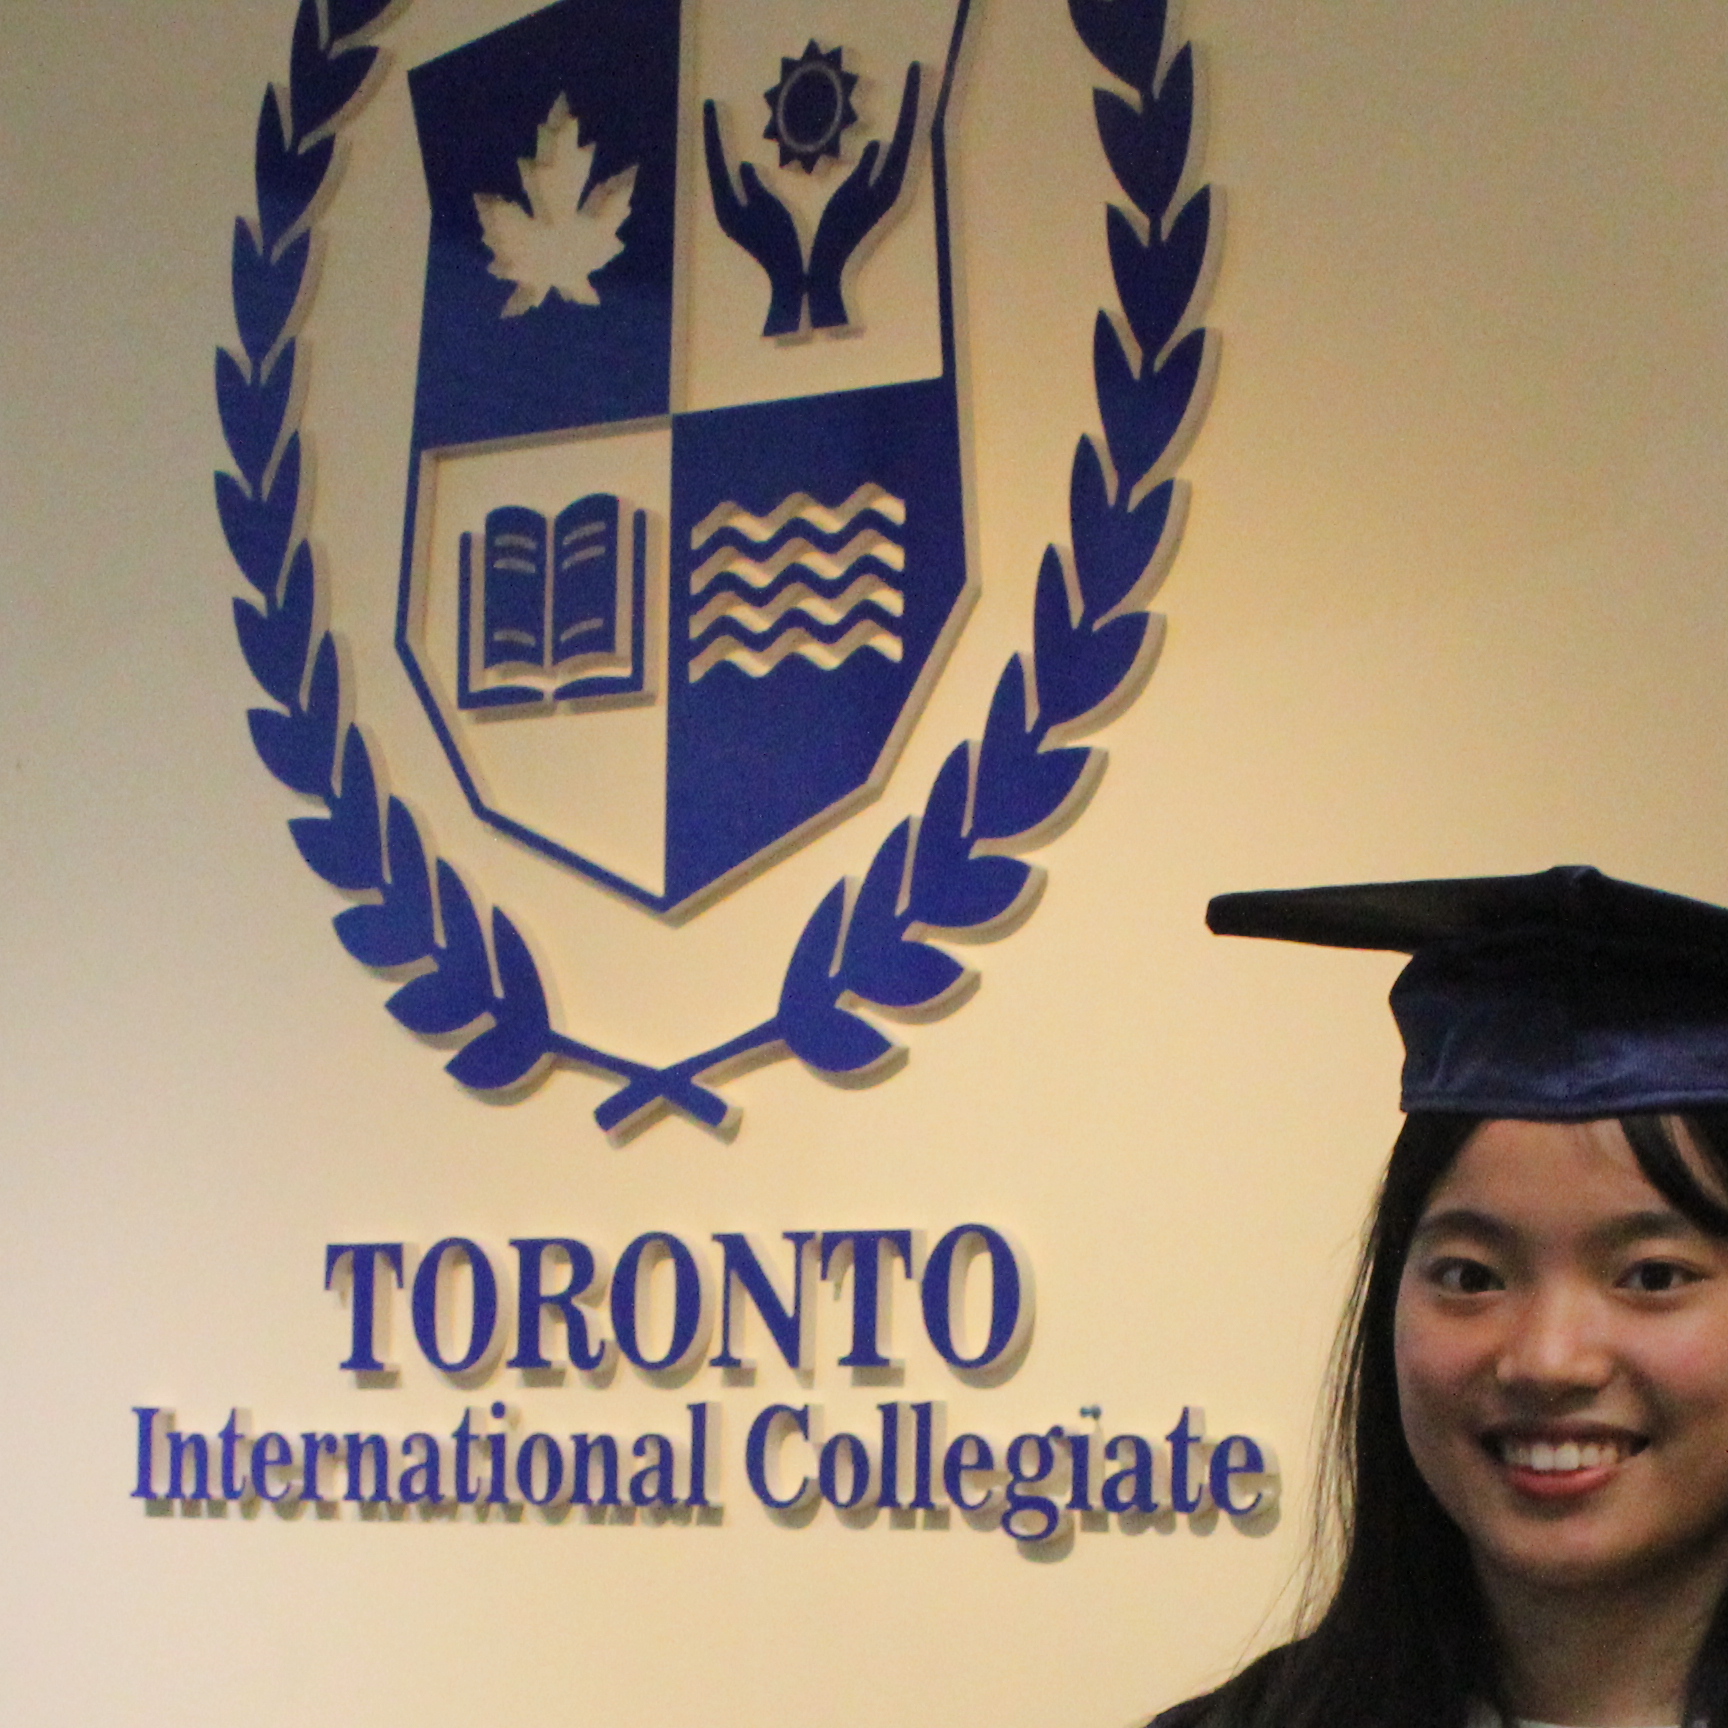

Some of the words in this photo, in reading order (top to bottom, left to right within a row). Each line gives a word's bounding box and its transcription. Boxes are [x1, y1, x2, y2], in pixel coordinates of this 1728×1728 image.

[323, 1222, 1024, 1372] TORONTO
[129, 1401, 711, 1508] International
[744, 1401, 1266, 1542] Collegiate
